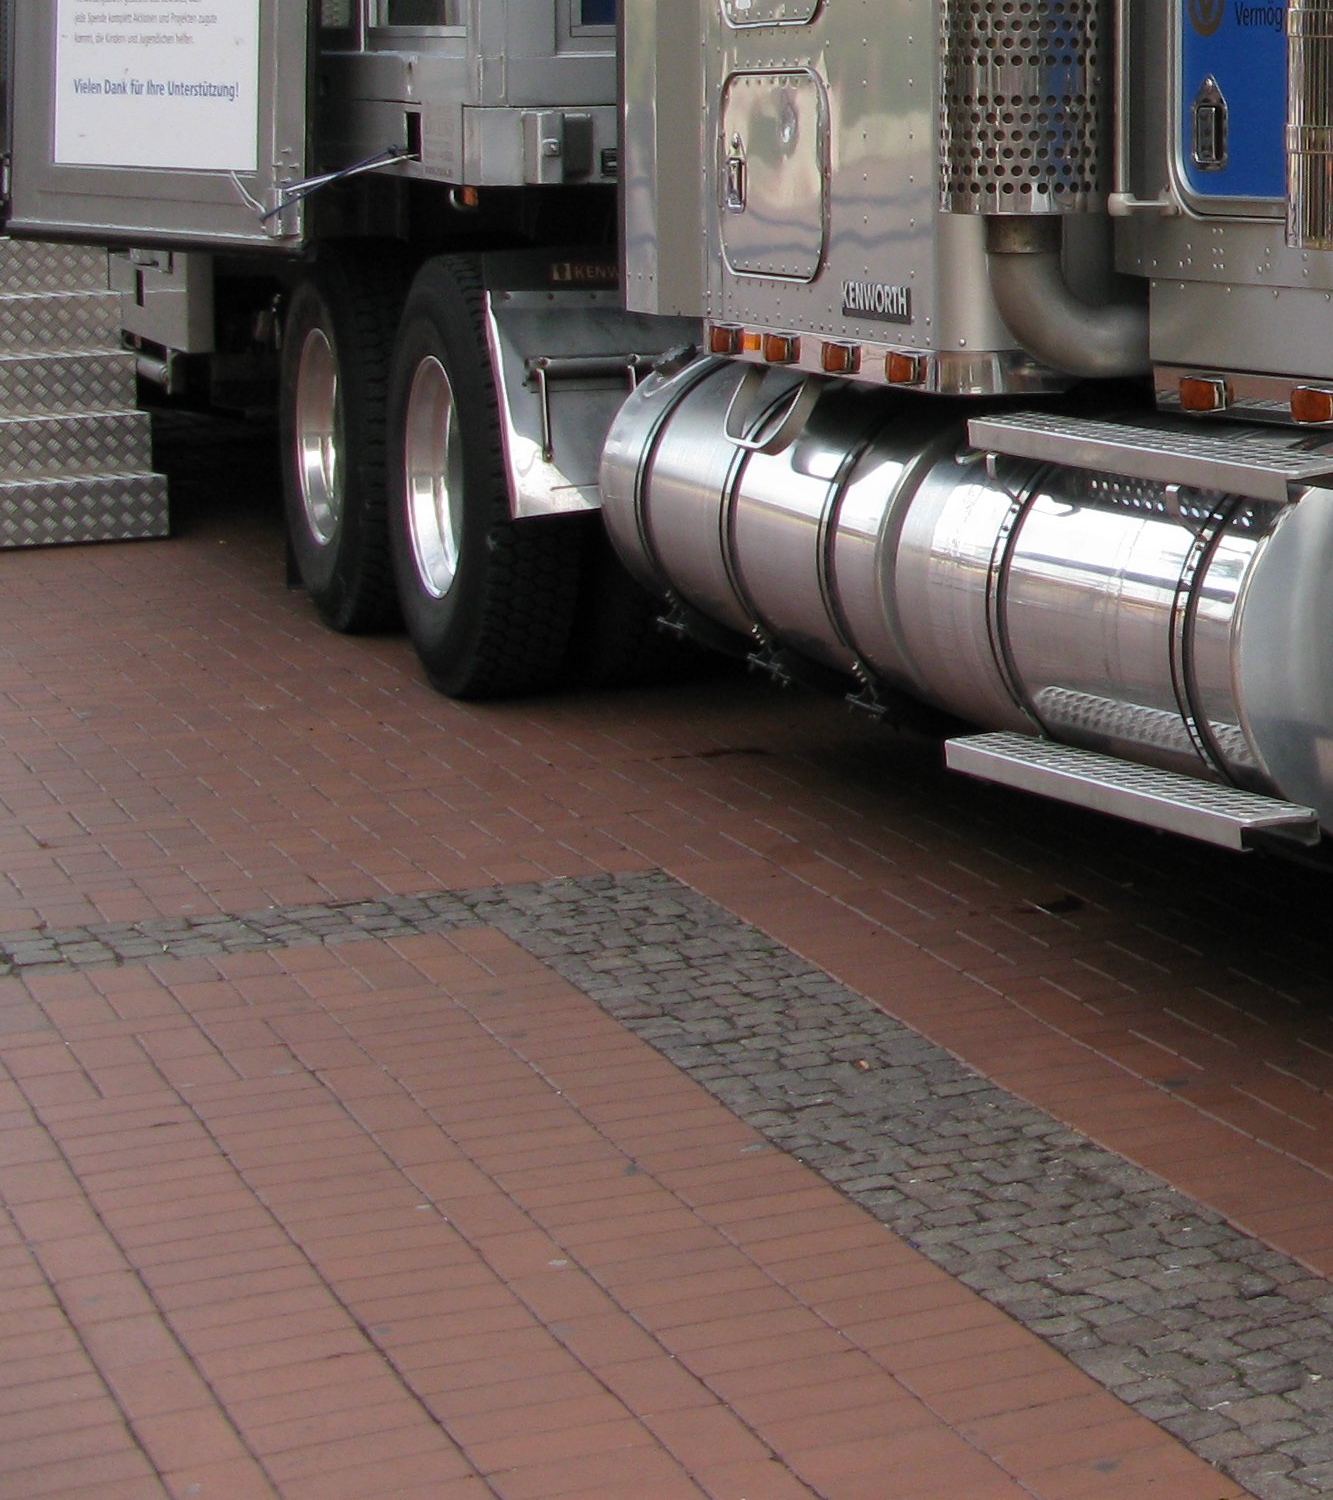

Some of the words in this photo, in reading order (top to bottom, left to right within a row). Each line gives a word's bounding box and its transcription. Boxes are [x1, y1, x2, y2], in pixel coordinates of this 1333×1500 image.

[1234, 0, 1283, 33] Vermög
[74, 78, 101, 94] Vielen
[104, 78, 128, 95] Dank
[130, 79, 144, 95] für
[147, 79, 164, 96] Ihre
[168, 80, 239, 102] Unterstützung!
[575, 265, 618, 278] KENW
[841, 280, 908, 316] KENWORTH
